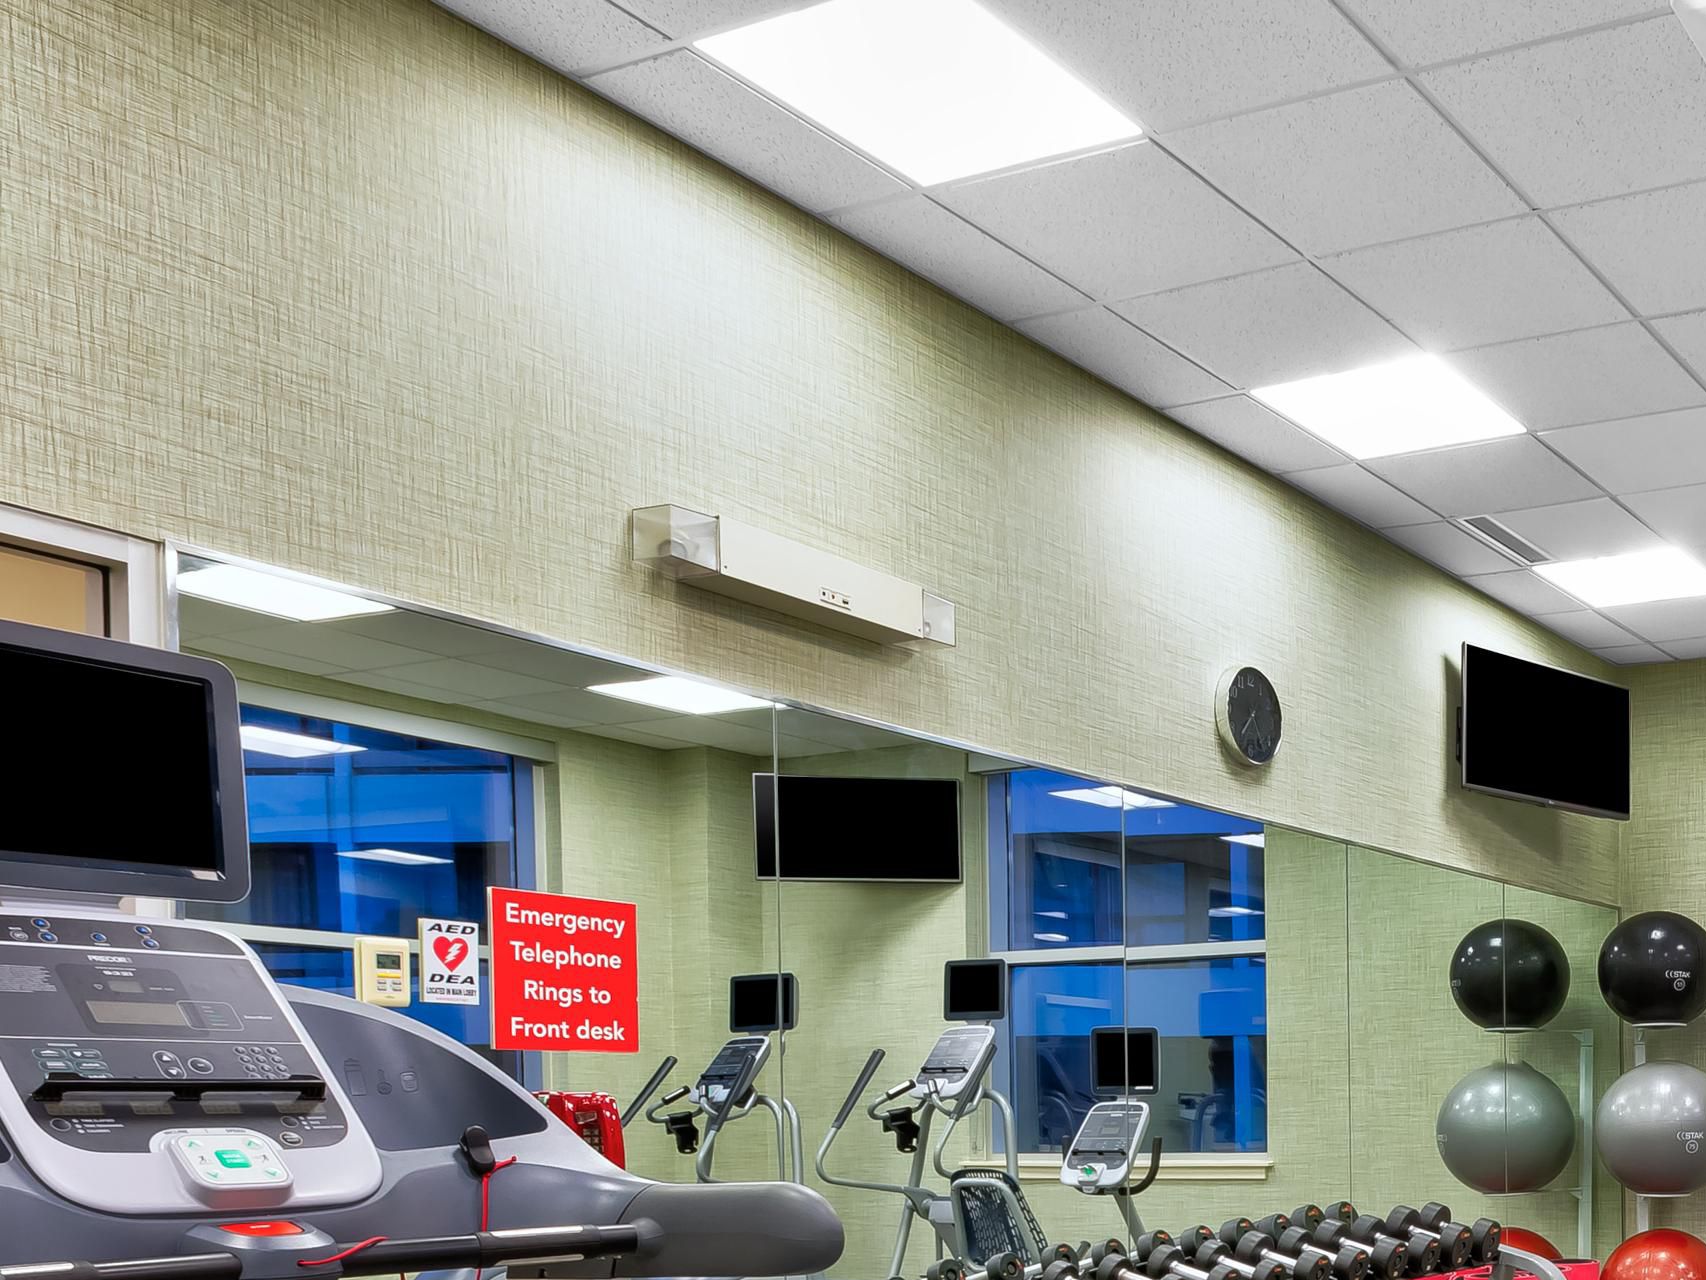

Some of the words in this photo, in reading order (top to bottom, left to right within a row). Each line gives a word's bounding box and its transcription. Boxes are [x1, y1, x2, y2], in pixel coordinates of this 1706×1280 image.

[428, 923, 476, 935] AED
[505, 902, 626, 939] Emergency
[509, 940, 622, 970] Telephone
[426, 986, 445, 995] LOCATED
[452, 988, 463, 996] MAIN
[463, 988, 477, 997] LOBBY
[429, 973, 475, 985] DEA
[524, 979, 583, 1007] Rings
[589, 986, 612, 1005] to
[510, 1016, 570, 1039] Front
[576, 1019, 625, 1041] desk
